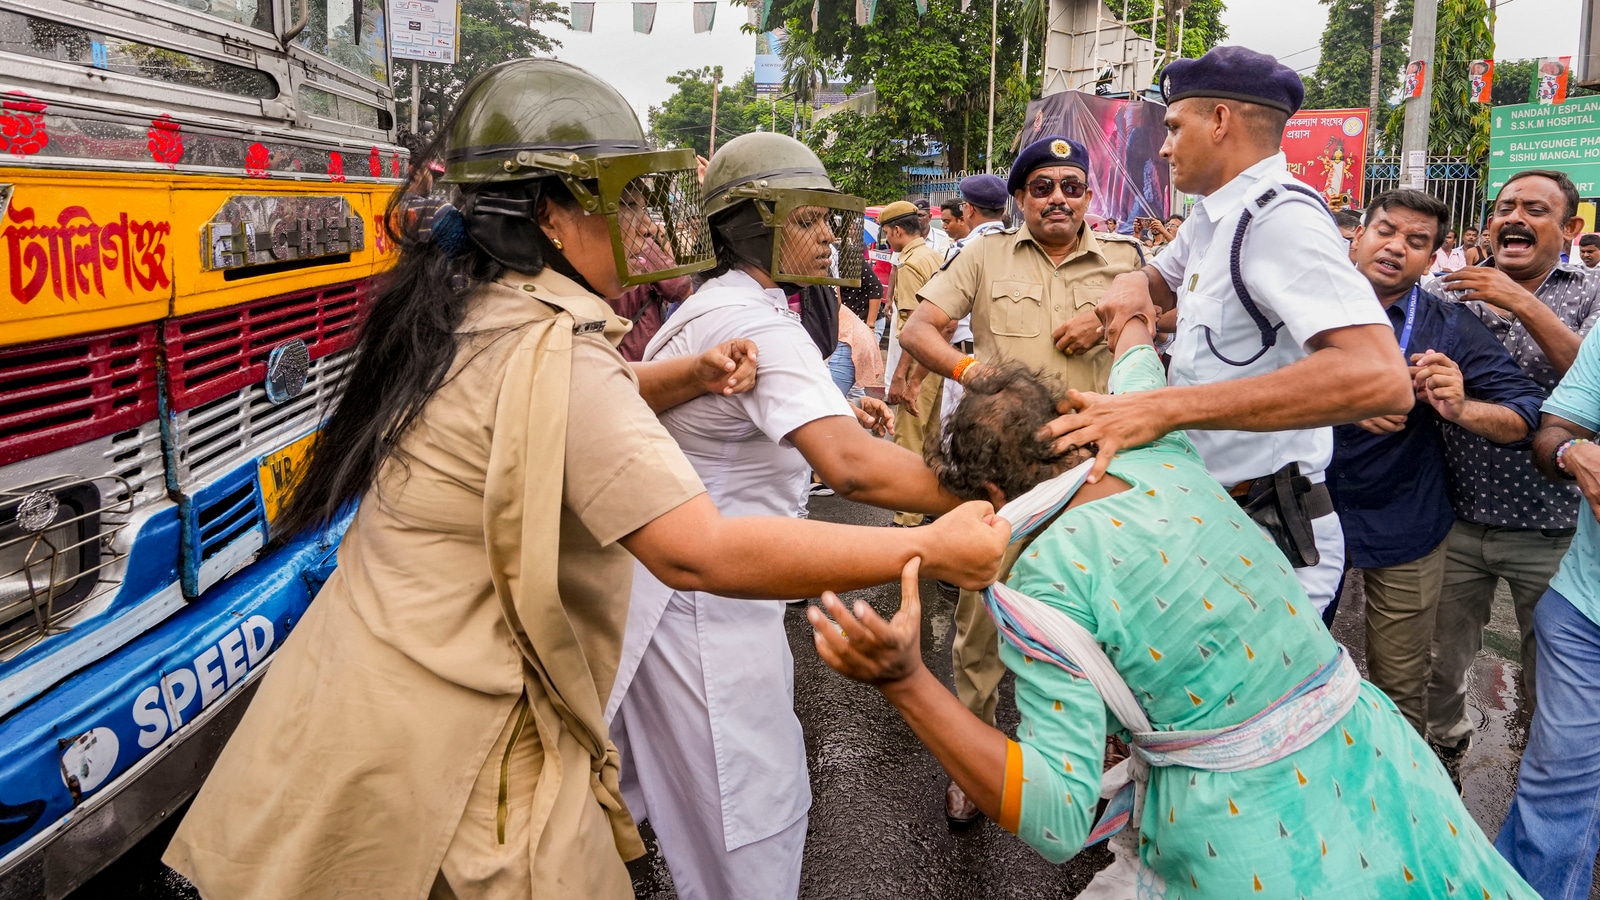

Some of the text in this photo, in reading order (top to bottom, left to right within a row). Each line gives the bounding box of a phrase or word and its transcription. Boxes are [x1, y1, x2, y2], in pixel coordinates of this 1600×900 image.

[1511, 107, 1551, 119] NANDAN
[1558, 102, 1600, 114] ESPLAN
[1511, 115, 1595, 130] S.S.K.M HOSPITAL
[1286, 129, 1311, 139] প্রয়াস
[1510, 138, 1577, 151] BALLYGUNGE
[1509, 152, 1537, 162] SISHU
[1539, 149, 1581, 161] MANGAL
[1, 197, 171, 305] টালিগঞ্জ
[132, 615, 275, 749] SPEED
